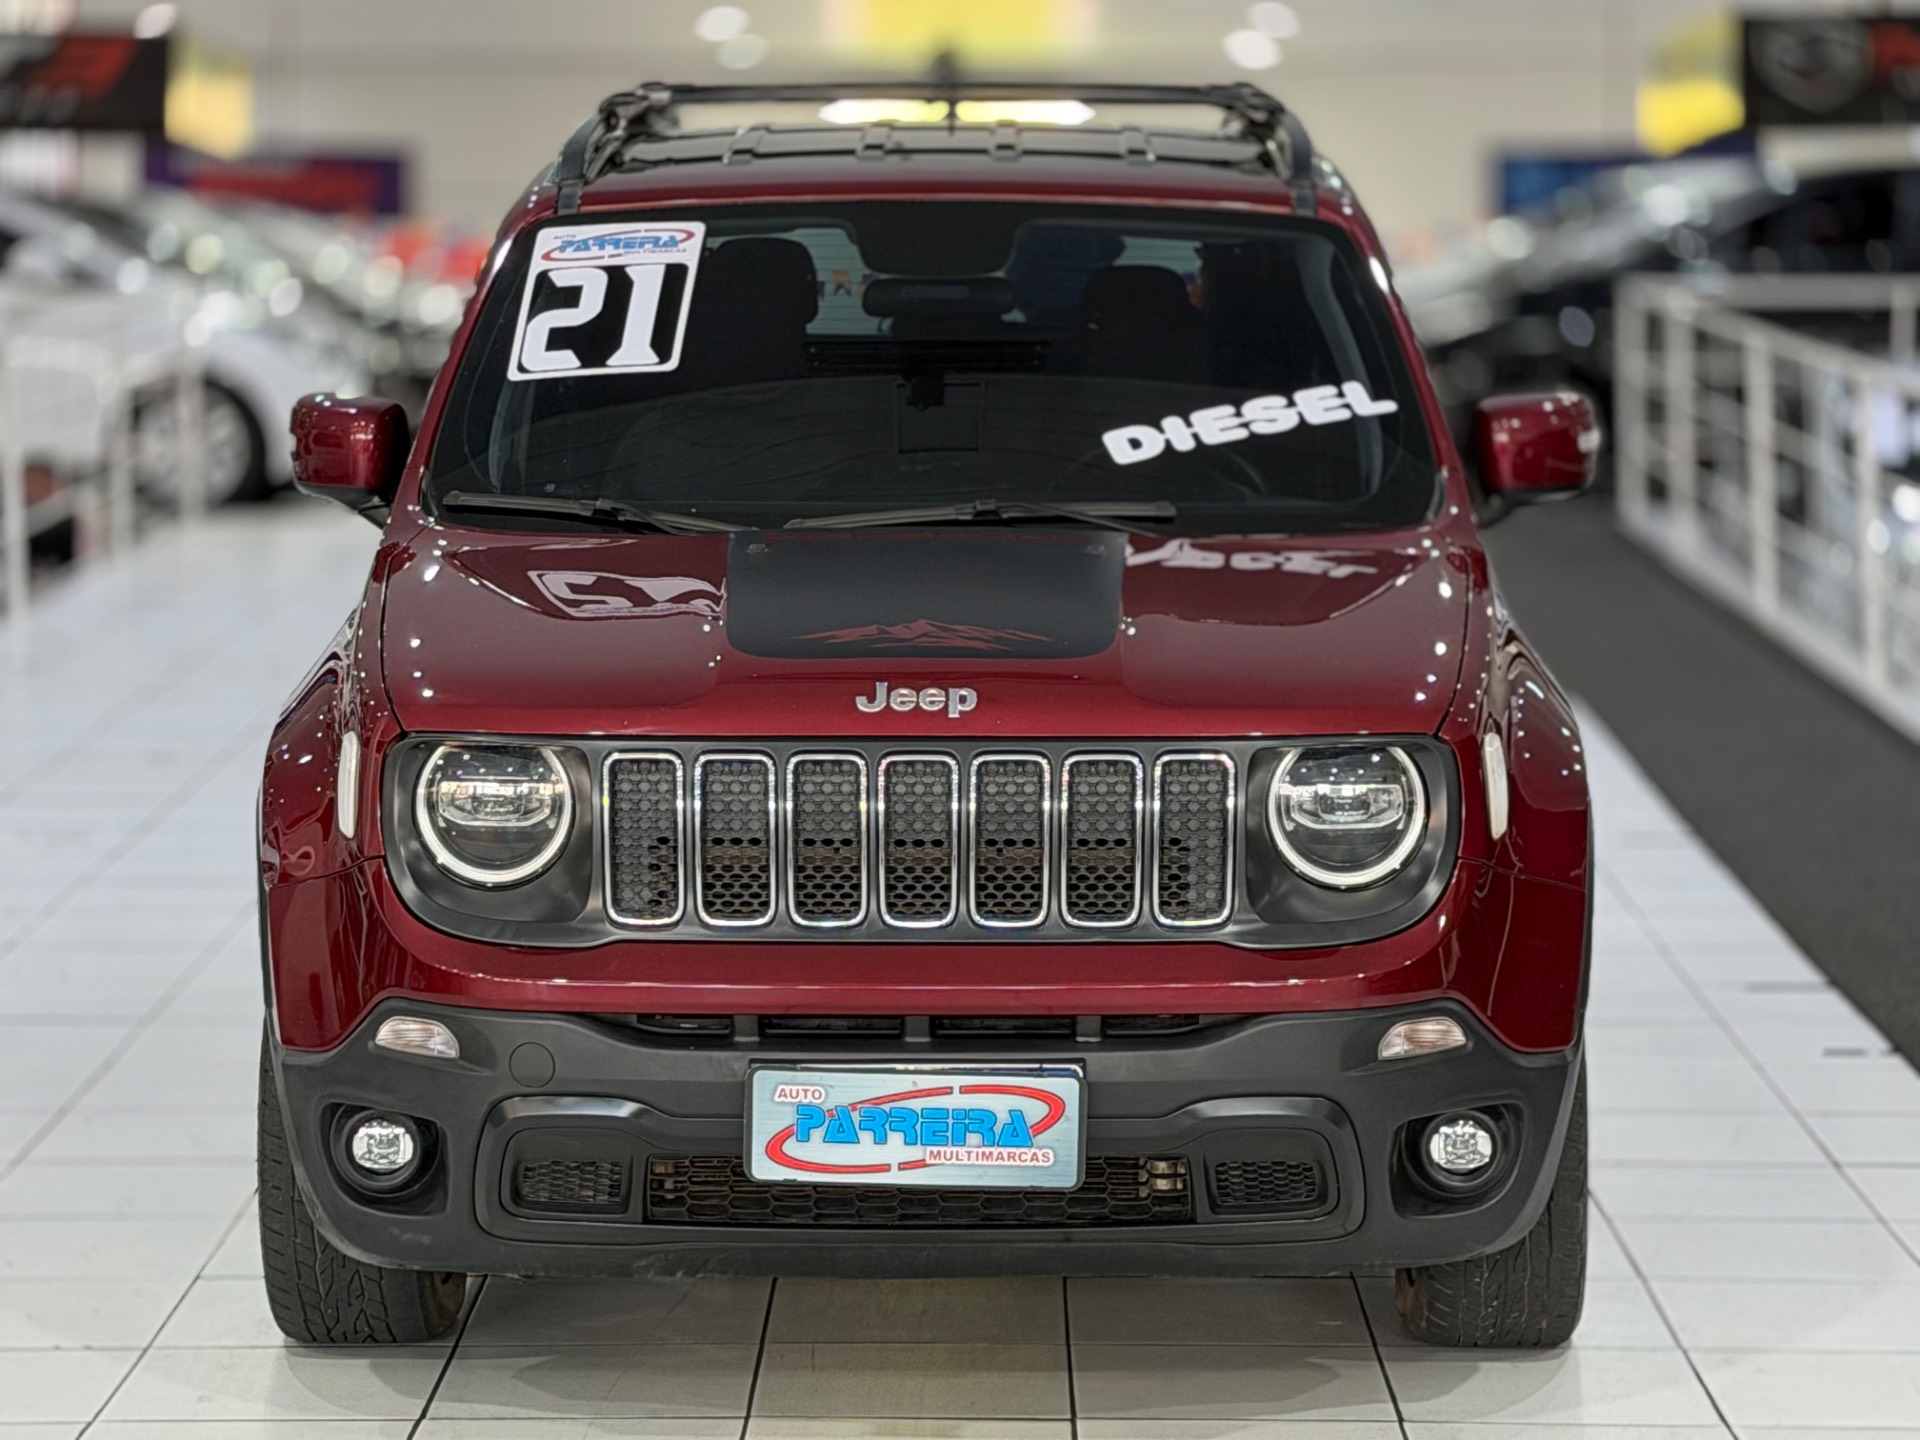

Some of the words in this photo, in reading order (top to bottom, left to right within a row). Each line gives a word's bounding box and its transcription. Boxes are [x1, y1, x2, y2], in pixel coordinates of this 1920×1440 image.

[520, 264, 666, 372] 21
[1102, 380, 1399, 465] DIESEL
[855, 682, 978, 718] Jeep
[777, 1088, 823, 1101] AUTO
[796, 1104, 1034, 1147] PARREIRA
[928, 1150, 1051, 1164] MULTIMARCAS
